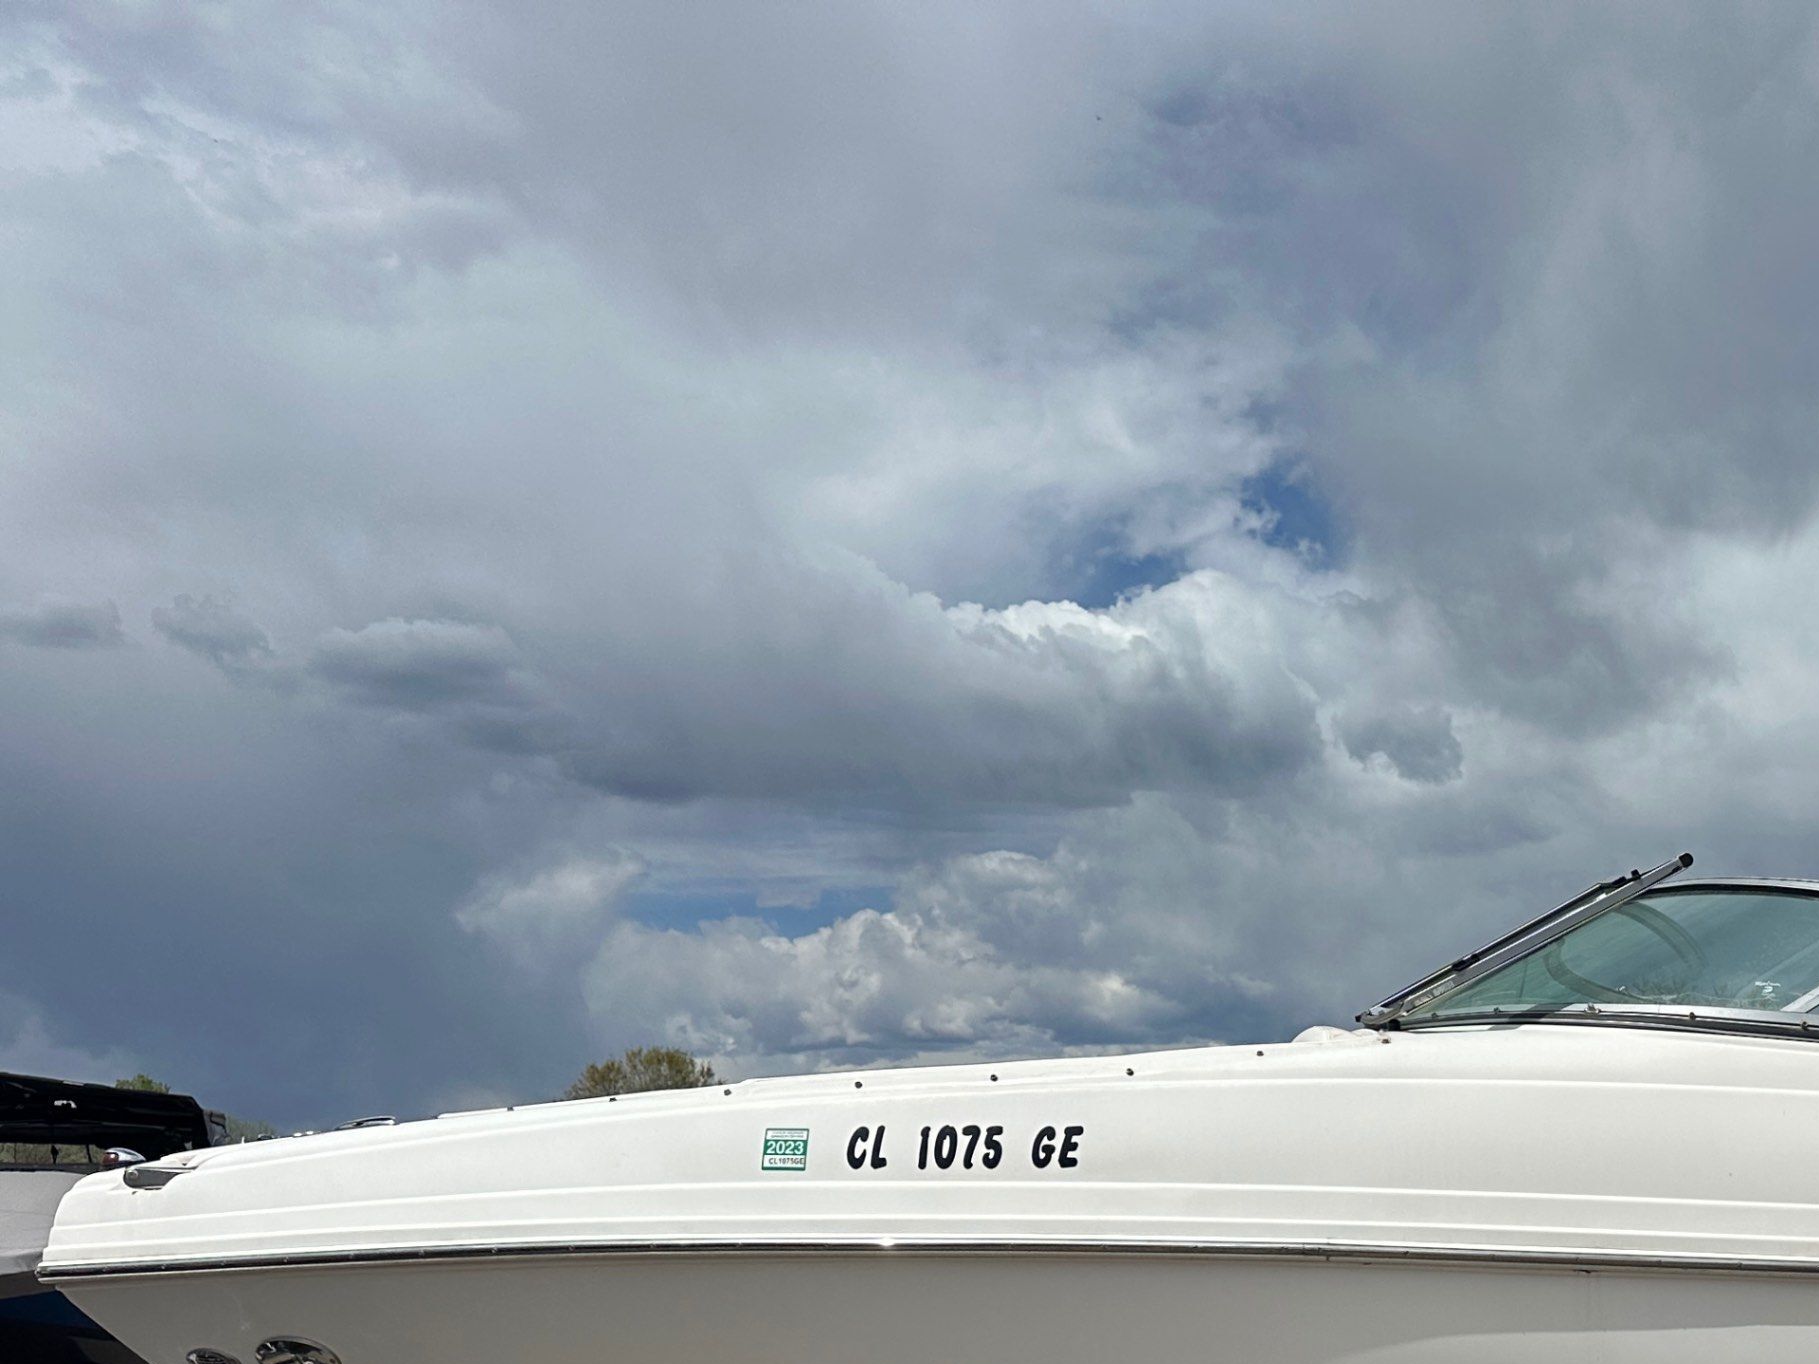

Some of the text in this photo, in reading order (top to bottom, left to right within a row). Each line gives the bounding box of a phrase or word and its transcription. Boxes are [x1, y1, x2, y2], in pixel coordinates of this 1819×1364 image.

[766, 1141, 804, 1155] 2023
[846, 1125, 1084, 1170] CL 1075 GE
